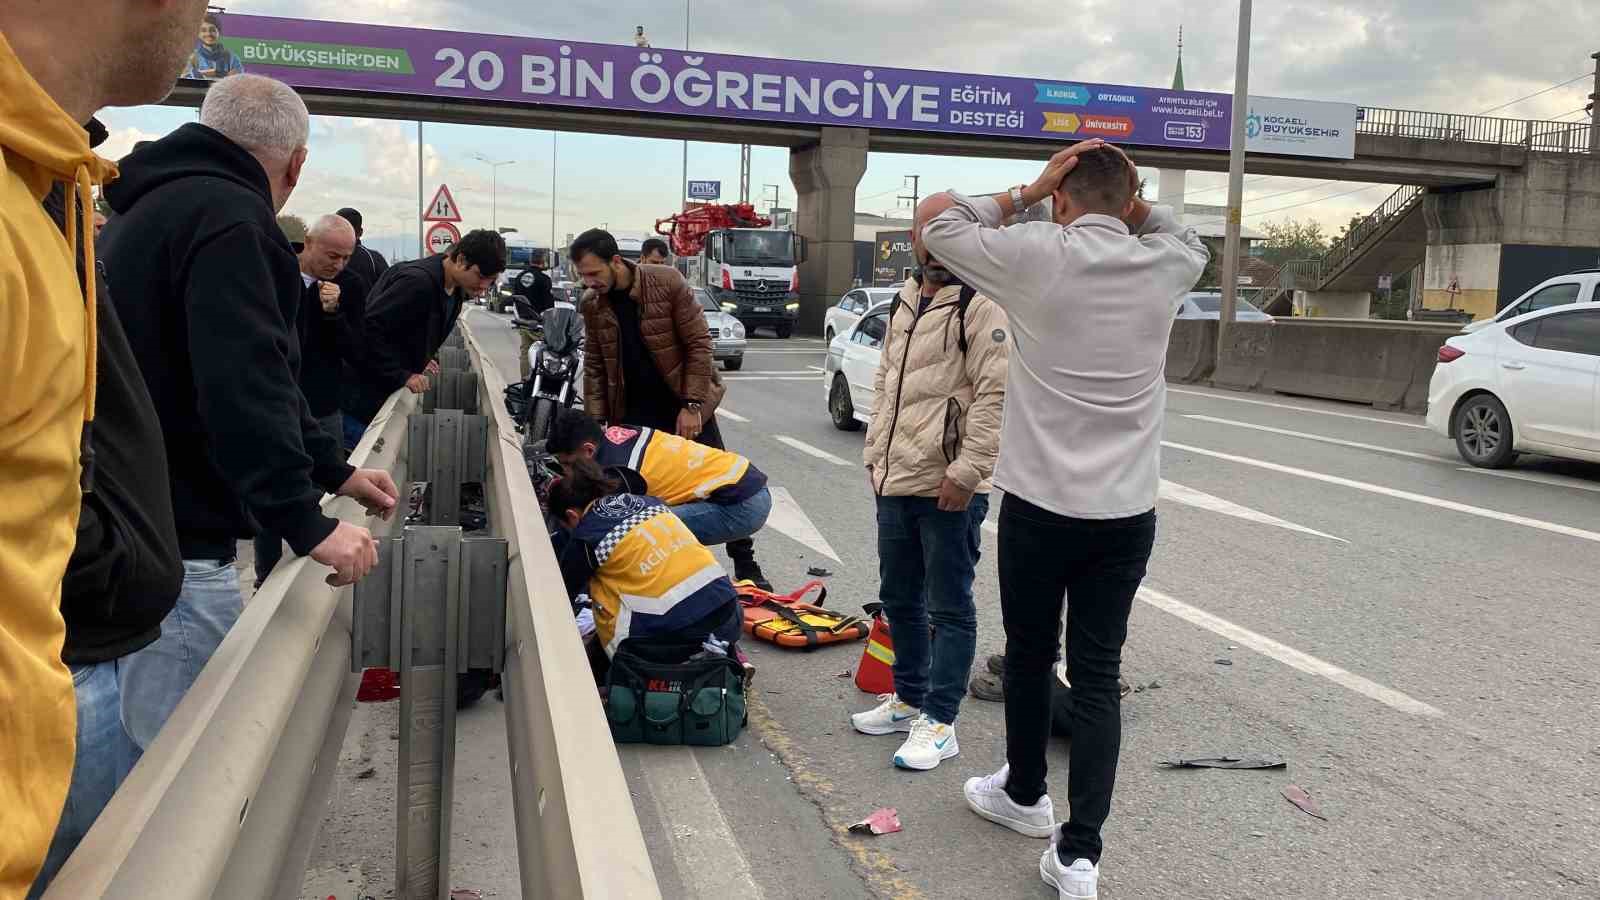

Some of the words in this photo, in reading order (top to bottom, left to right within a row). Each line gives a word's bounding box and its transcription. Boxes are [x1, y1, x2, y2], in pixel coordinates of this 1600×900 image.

[434, 47, 504, 91] 20
[521, 45, 615, 100] BİN
[630, 52, 940, 124] ÖĞRENCİYE
[950, 85, 1012, 106] EĞİTİM
[1097, 92, 1137, 104] ORTAOKUL
[949, 110, 1025, 130] DESTEĞİ
[1085, 118, 1129, 131] ÜNİVERSİTE
[1185, 125, 1202, 138] 153
